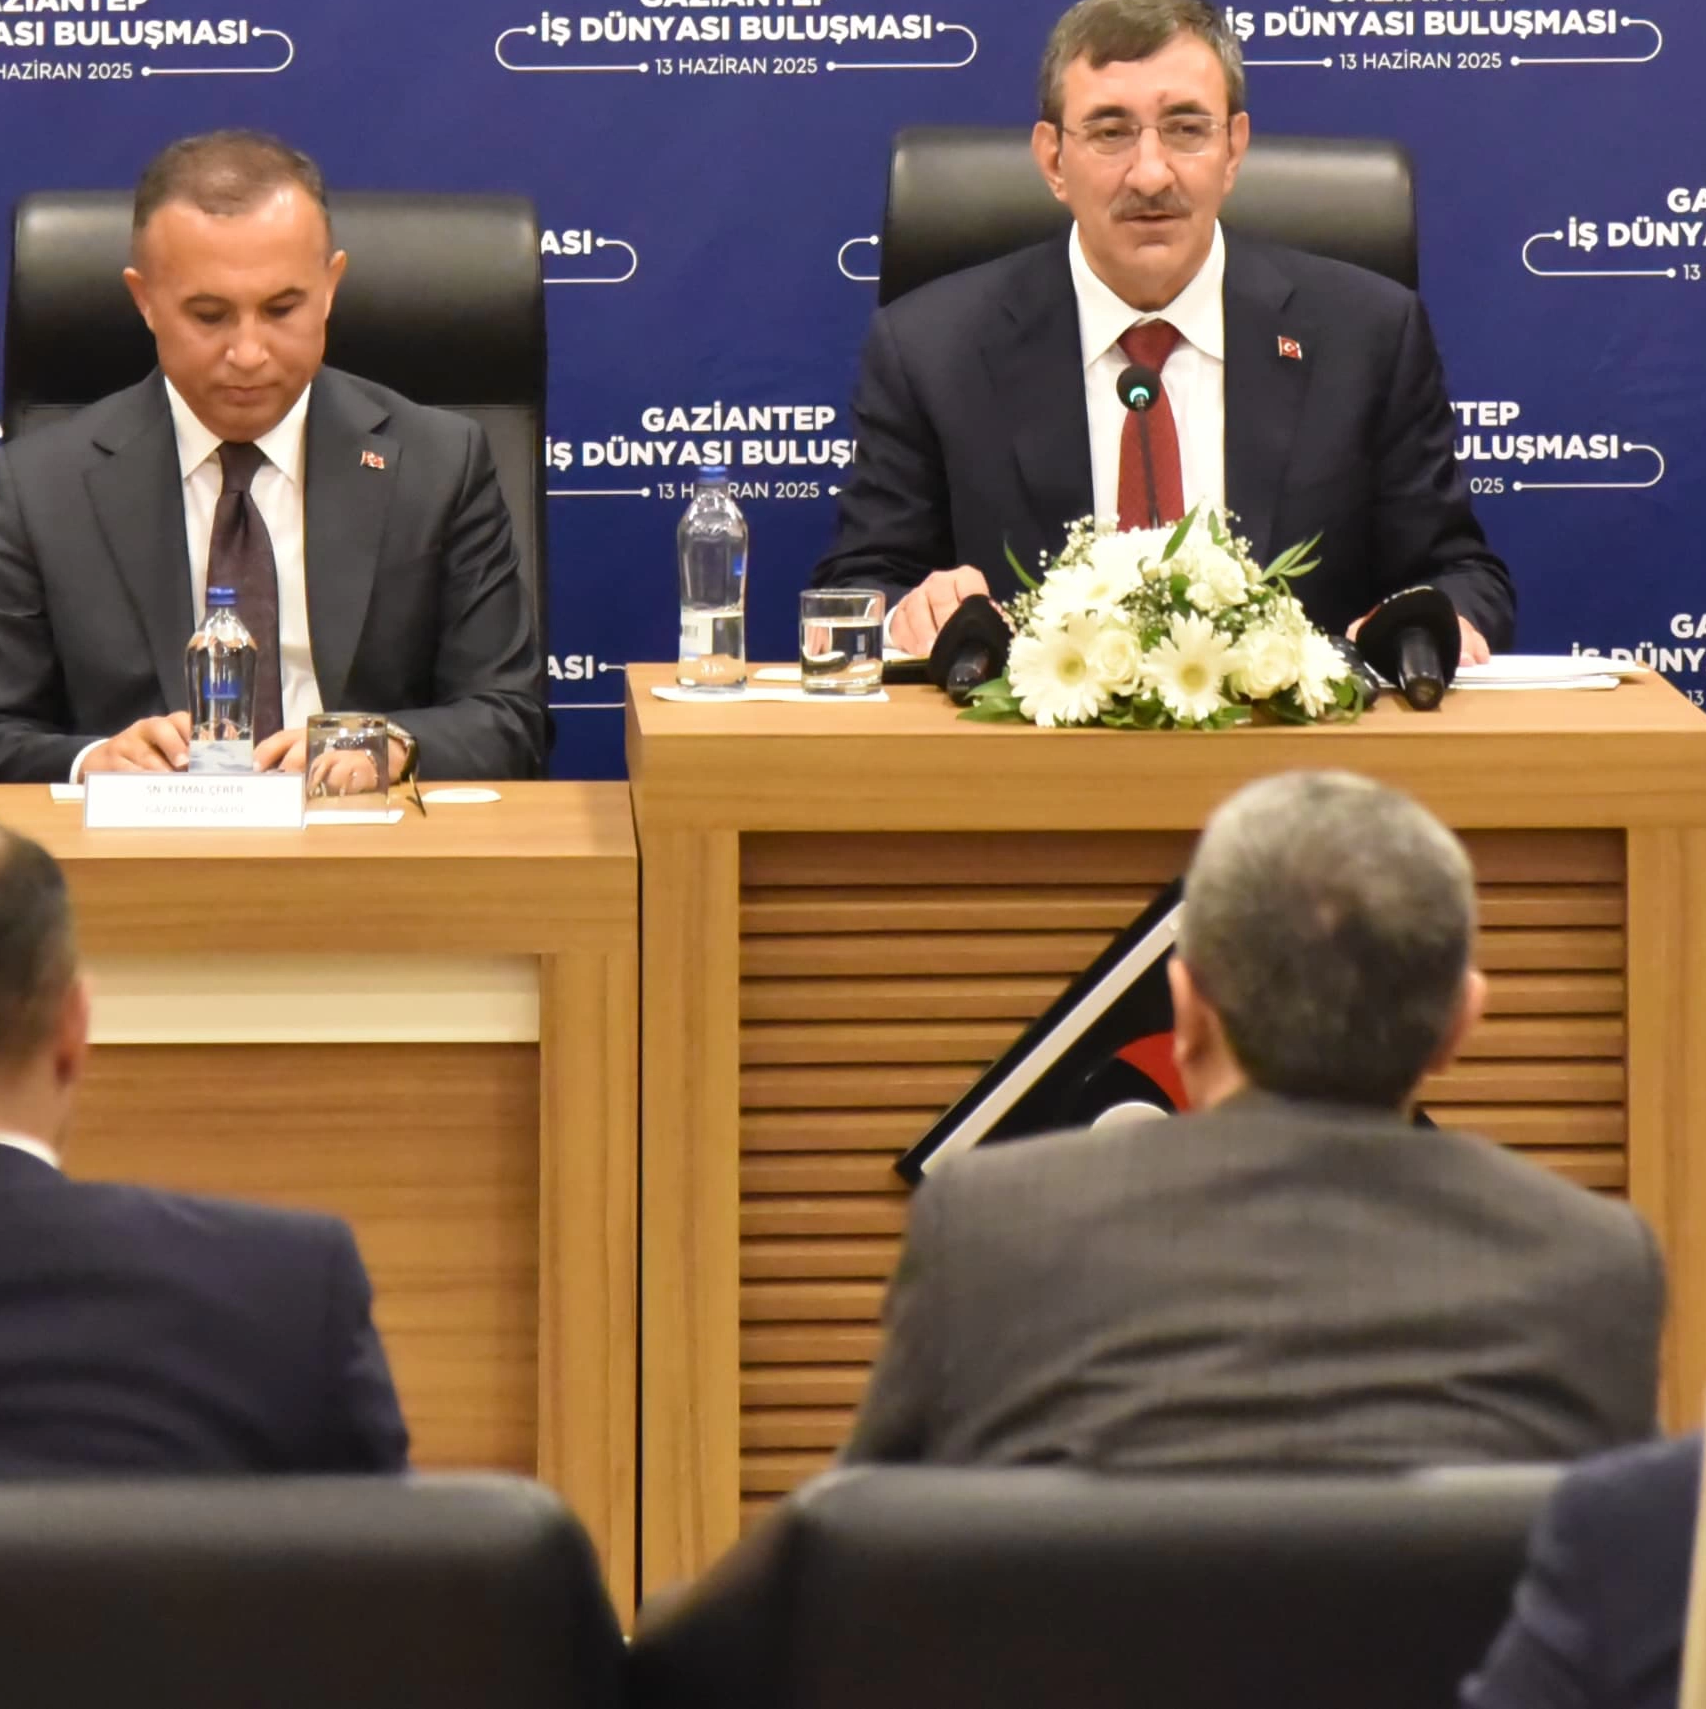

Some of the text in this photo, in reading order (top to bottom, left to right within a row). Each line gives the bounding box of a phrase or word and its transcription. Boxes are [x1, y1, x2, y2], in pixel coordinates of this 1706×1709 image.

[53, 18, 248, 51] BULUŞMASI
[540, 9, 932, 48] İŞ DÜNYASI BULUŞMASI
[1226, 5, 1617, 42] İŞ DÜNYASI BULUŞMASI
[87, 62, 133, 80] 2025
[654, 53, 818, 76] 13 HAZİRAN 2025
[1338, 48, 1503, 70] 13 HAZİRAN 2025
[1568, 215, 1599, 253] İŞ
[1682, 263, 1701, 281] 13
[641, 400, 836, 433] GAZİANTEP
[545, 435, 857, 472] İŞ DÜNYASI BULUŞ
[1453, 433, 1619, 465] ULUŞMASI
[657, 483, 675, 500] 13
[775, 481, 820, 499] 2025
[1469, 477, 1505, 494] 025
